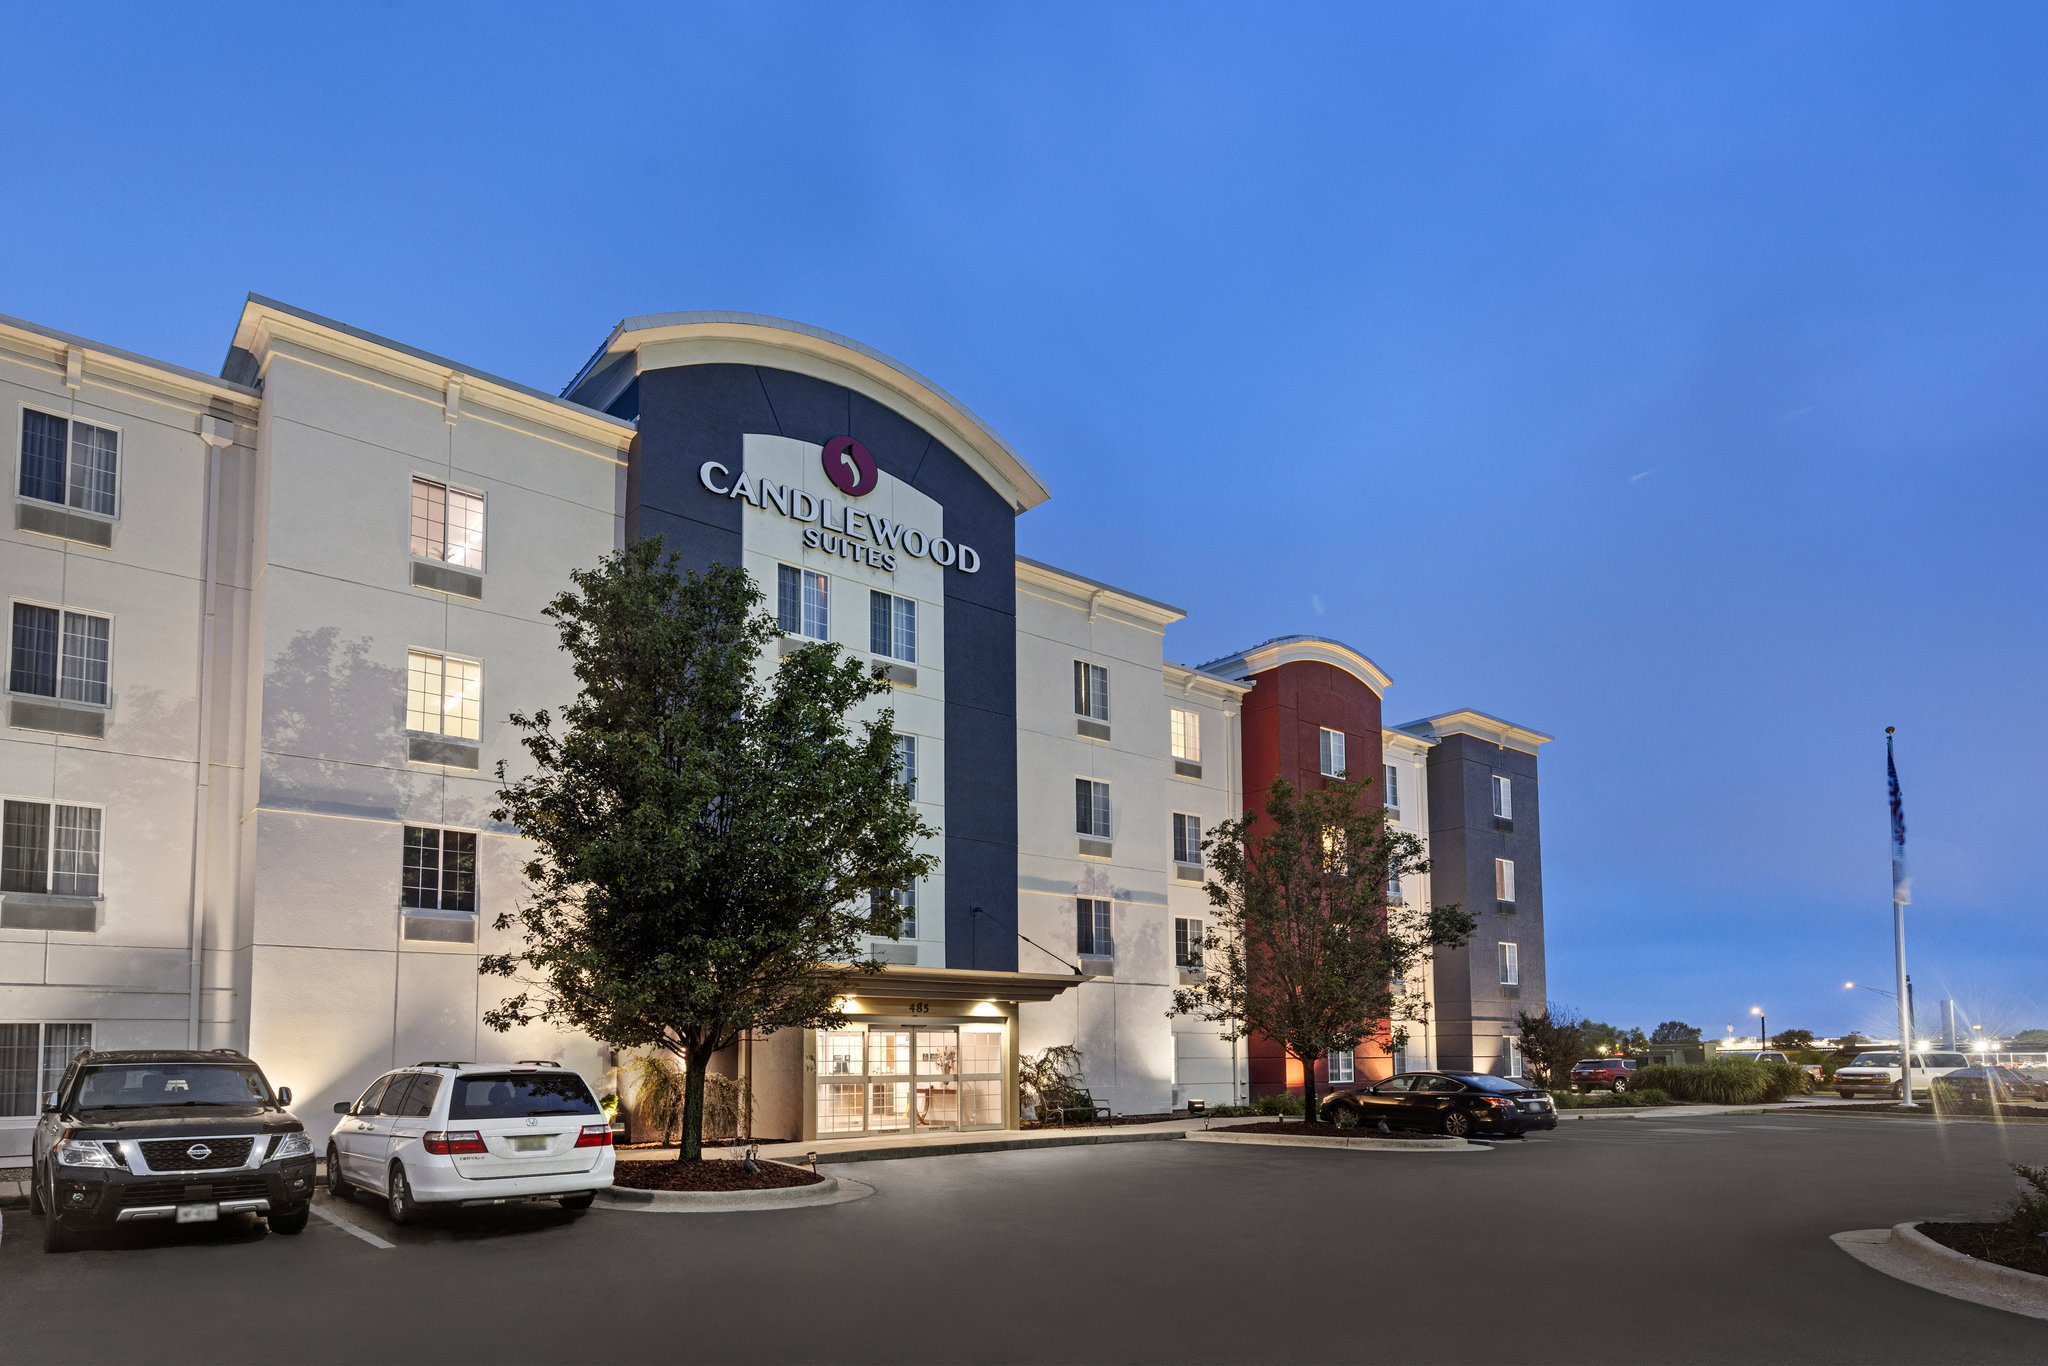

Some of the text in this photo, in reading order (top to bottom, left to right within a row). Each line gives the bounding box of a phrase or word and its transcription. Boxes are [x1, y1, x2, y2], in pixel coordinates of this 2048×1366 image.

[699, 461, 981, 573] CANDLEWOOD
[803, 528, 898, 572] SUITES
[909, 1003, 929, 1013] 485
